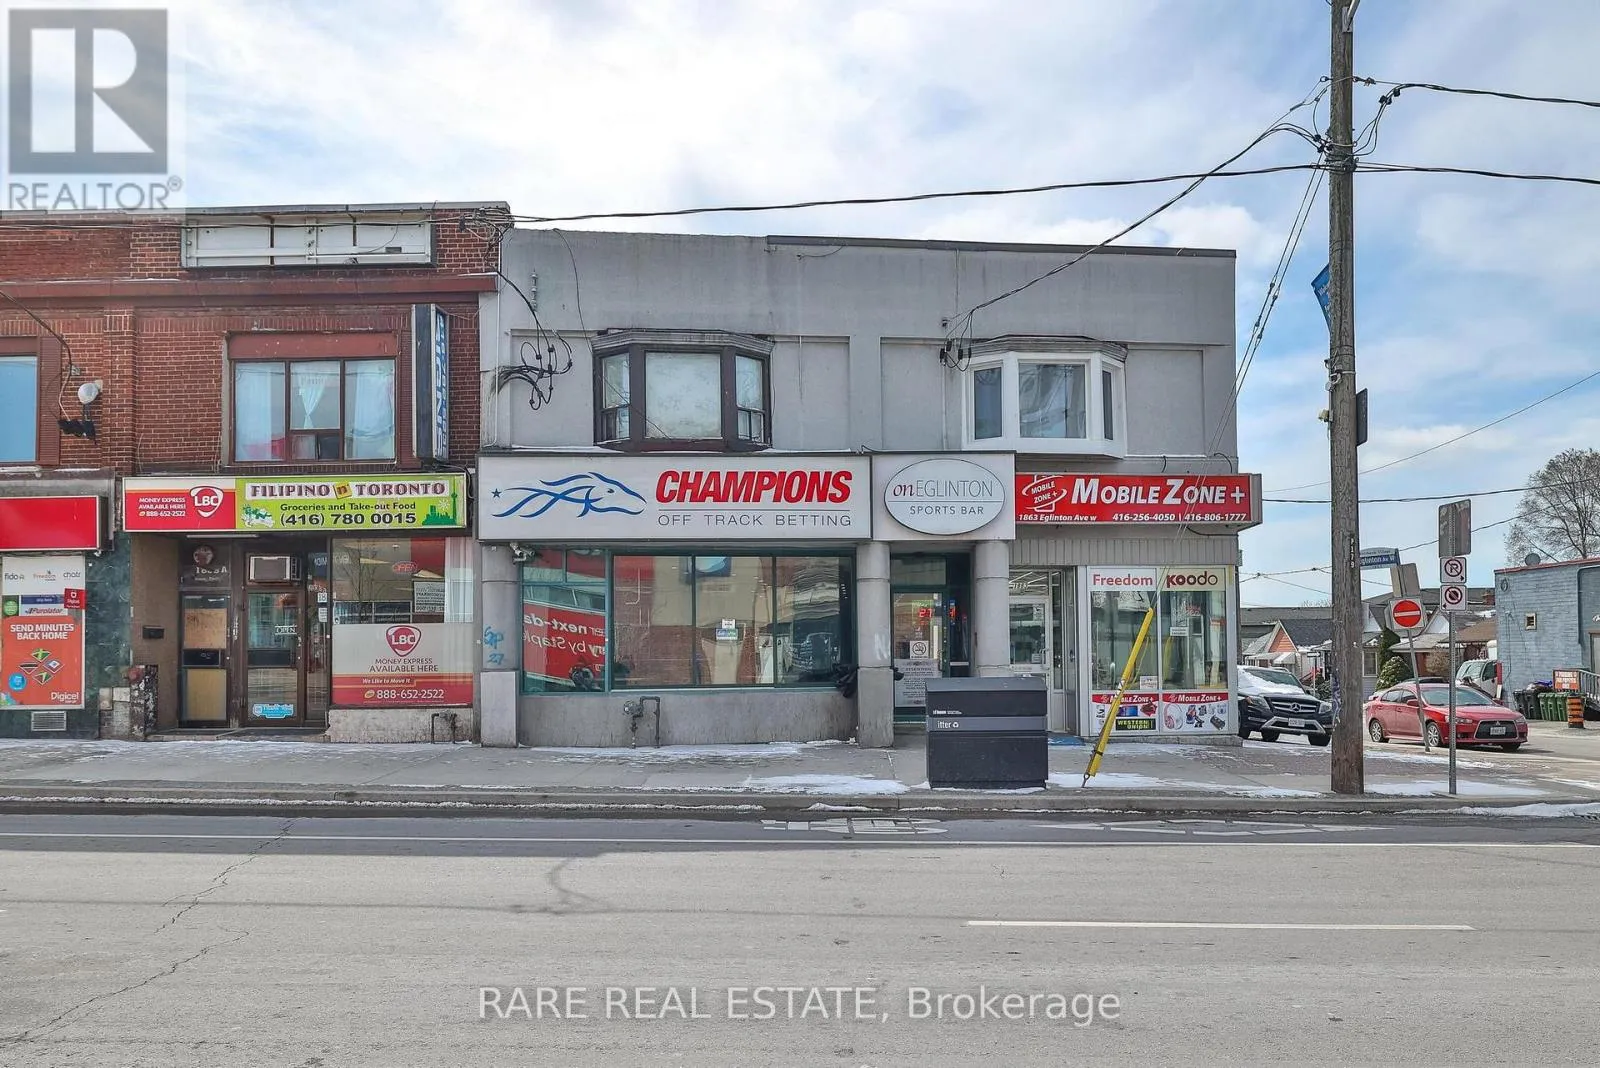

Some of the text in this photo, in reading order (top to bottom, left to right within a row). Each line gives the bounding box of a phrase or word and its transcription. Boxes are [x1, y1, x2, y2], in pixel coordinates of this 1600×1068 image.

[251, 484, 330, 497] FILIPINO
[355, 483, 445, 496] TORONTO
[656, 470, 852, 503] CHAMPIONS
[1031, 481, 1055, 494] MOBILE
[194, 495, 218, 507] LBC
[280, 502, 416, 512] Groceries and Take-out Food
[910, 506, 984, 515] SPORTS BAR
[280, 512, 416, 527] (416) 780 0015
[658, 514, 851, 526] OFF TRACK BETTING
[1040, 513, 1072, 522] Eglinton
[1112, 513, 1176, 521] 416-256-4050
[1184, 513, 1247, 521] 416-806-1777
[1360, 556, 1382, 567] glinton
[1093, 574, 1153, 586] Freedom
[1166, 571, 1218, 588] koodo
[10, 624, 74, 632] SEND MINUTES
[17, 632, 68, 640] BACK HOME
[391, 635, 416, 645] LBC
[51, 692, 79, 702] Digicel
[377, 689, 444, 699] 888-652-2522
